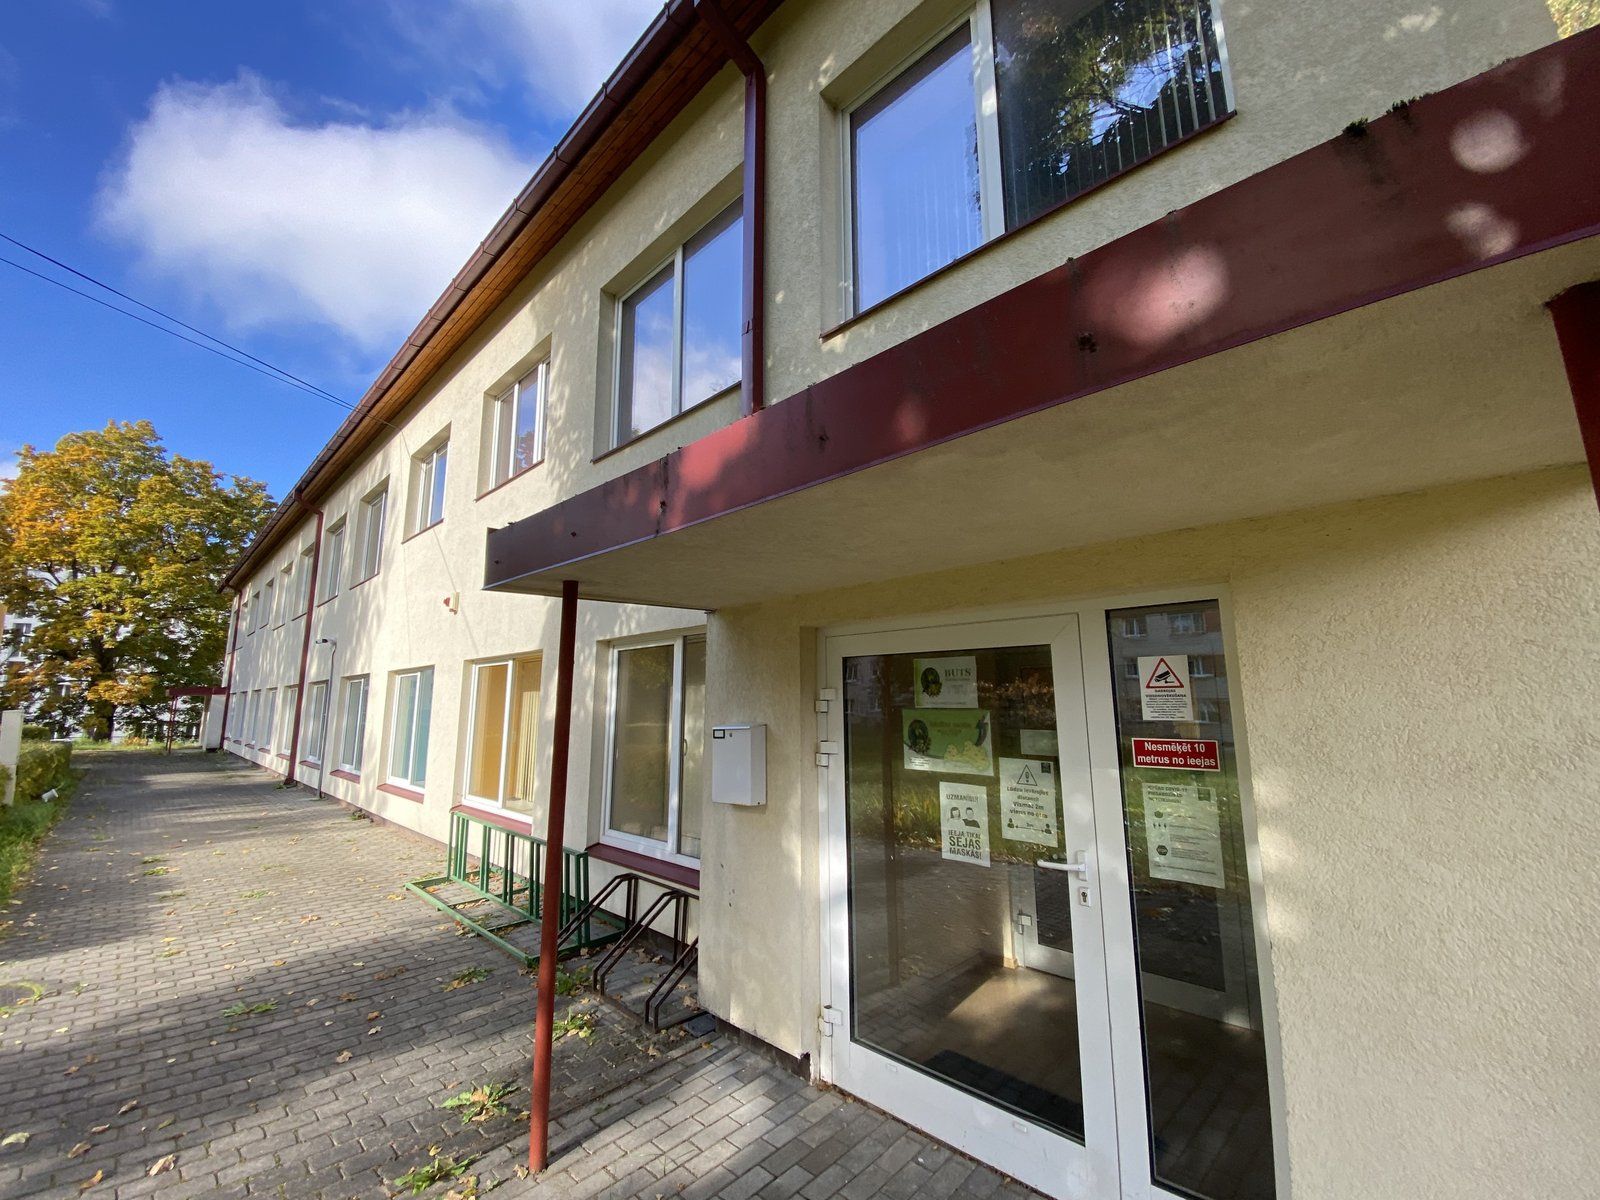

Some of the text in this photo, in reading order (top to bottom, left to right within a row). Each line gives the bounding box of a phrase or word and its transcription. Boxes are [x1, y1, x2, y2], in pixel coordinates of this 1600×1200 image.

[1144, 741, 1206, 754] Nesmēķēt 10
[1137, 754, 1216, 768] metrus no ieejas
[949, 836, 981, 850] SEJAS
